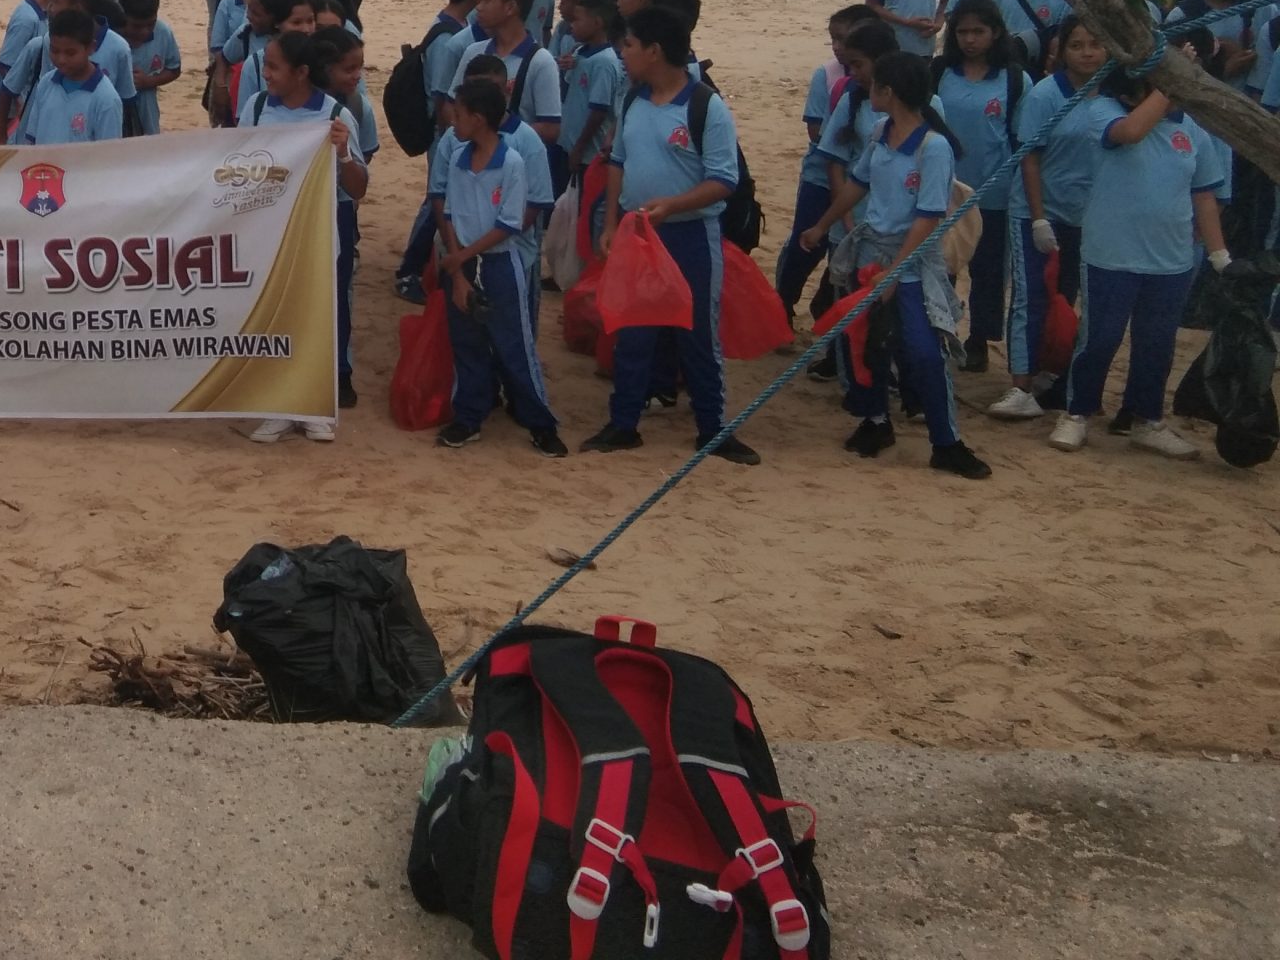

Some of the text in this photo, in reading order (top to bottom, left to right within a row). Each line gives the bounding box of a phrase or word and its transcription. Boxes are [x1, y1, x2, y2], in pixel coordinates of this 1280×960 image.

[43, 233, 252, 294] SOSIAL
[72, 309, 143, 331] PESTA
[150, 306, 216, 329] EMAS
[111, 339, 167, 360] BINA
[173, 335, 291, 358] WIRAWAN
